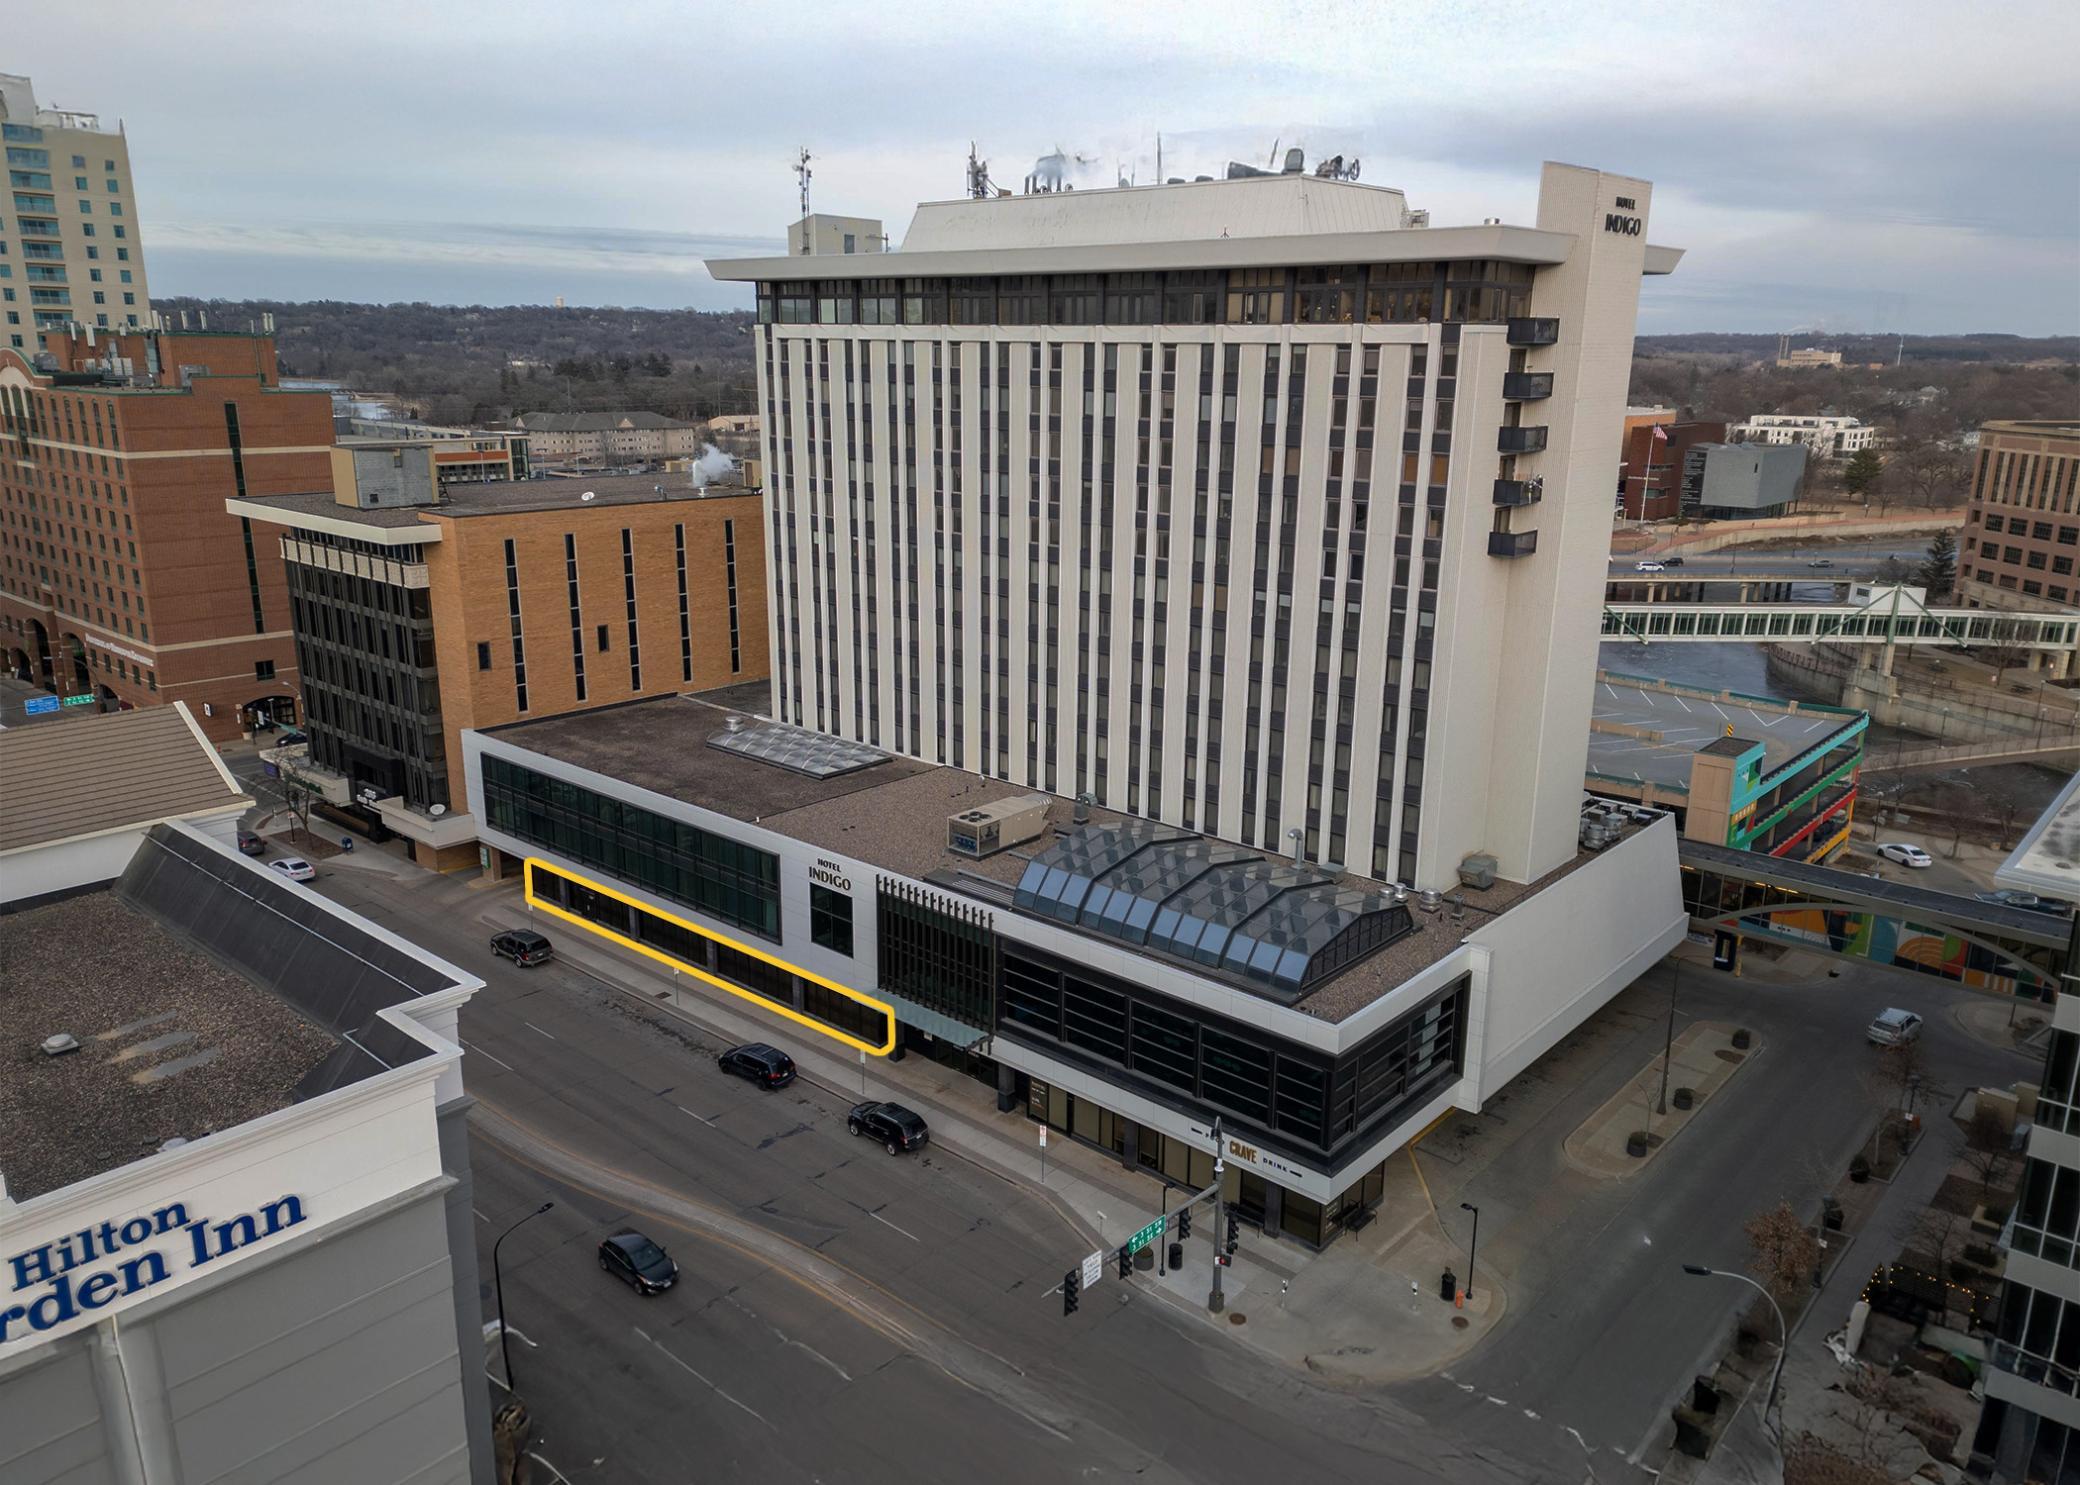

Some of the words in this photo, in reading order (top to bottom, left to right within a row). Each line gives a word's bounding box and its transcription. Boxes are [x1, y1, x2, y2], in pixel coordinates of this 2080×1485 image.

[1605, 213, 1642, 236] INDIGO
[809, 866, 852, 890] INDIGO
[817, 858, 842, 872] HOTEL
[1229, 1140, 1257, 1164] CRAVE
[1262, 1157, 1288, 1172] DRINK
[185, 1194, 307, 1268] Inn
[8, 1202, 191, 1292] Hilton
